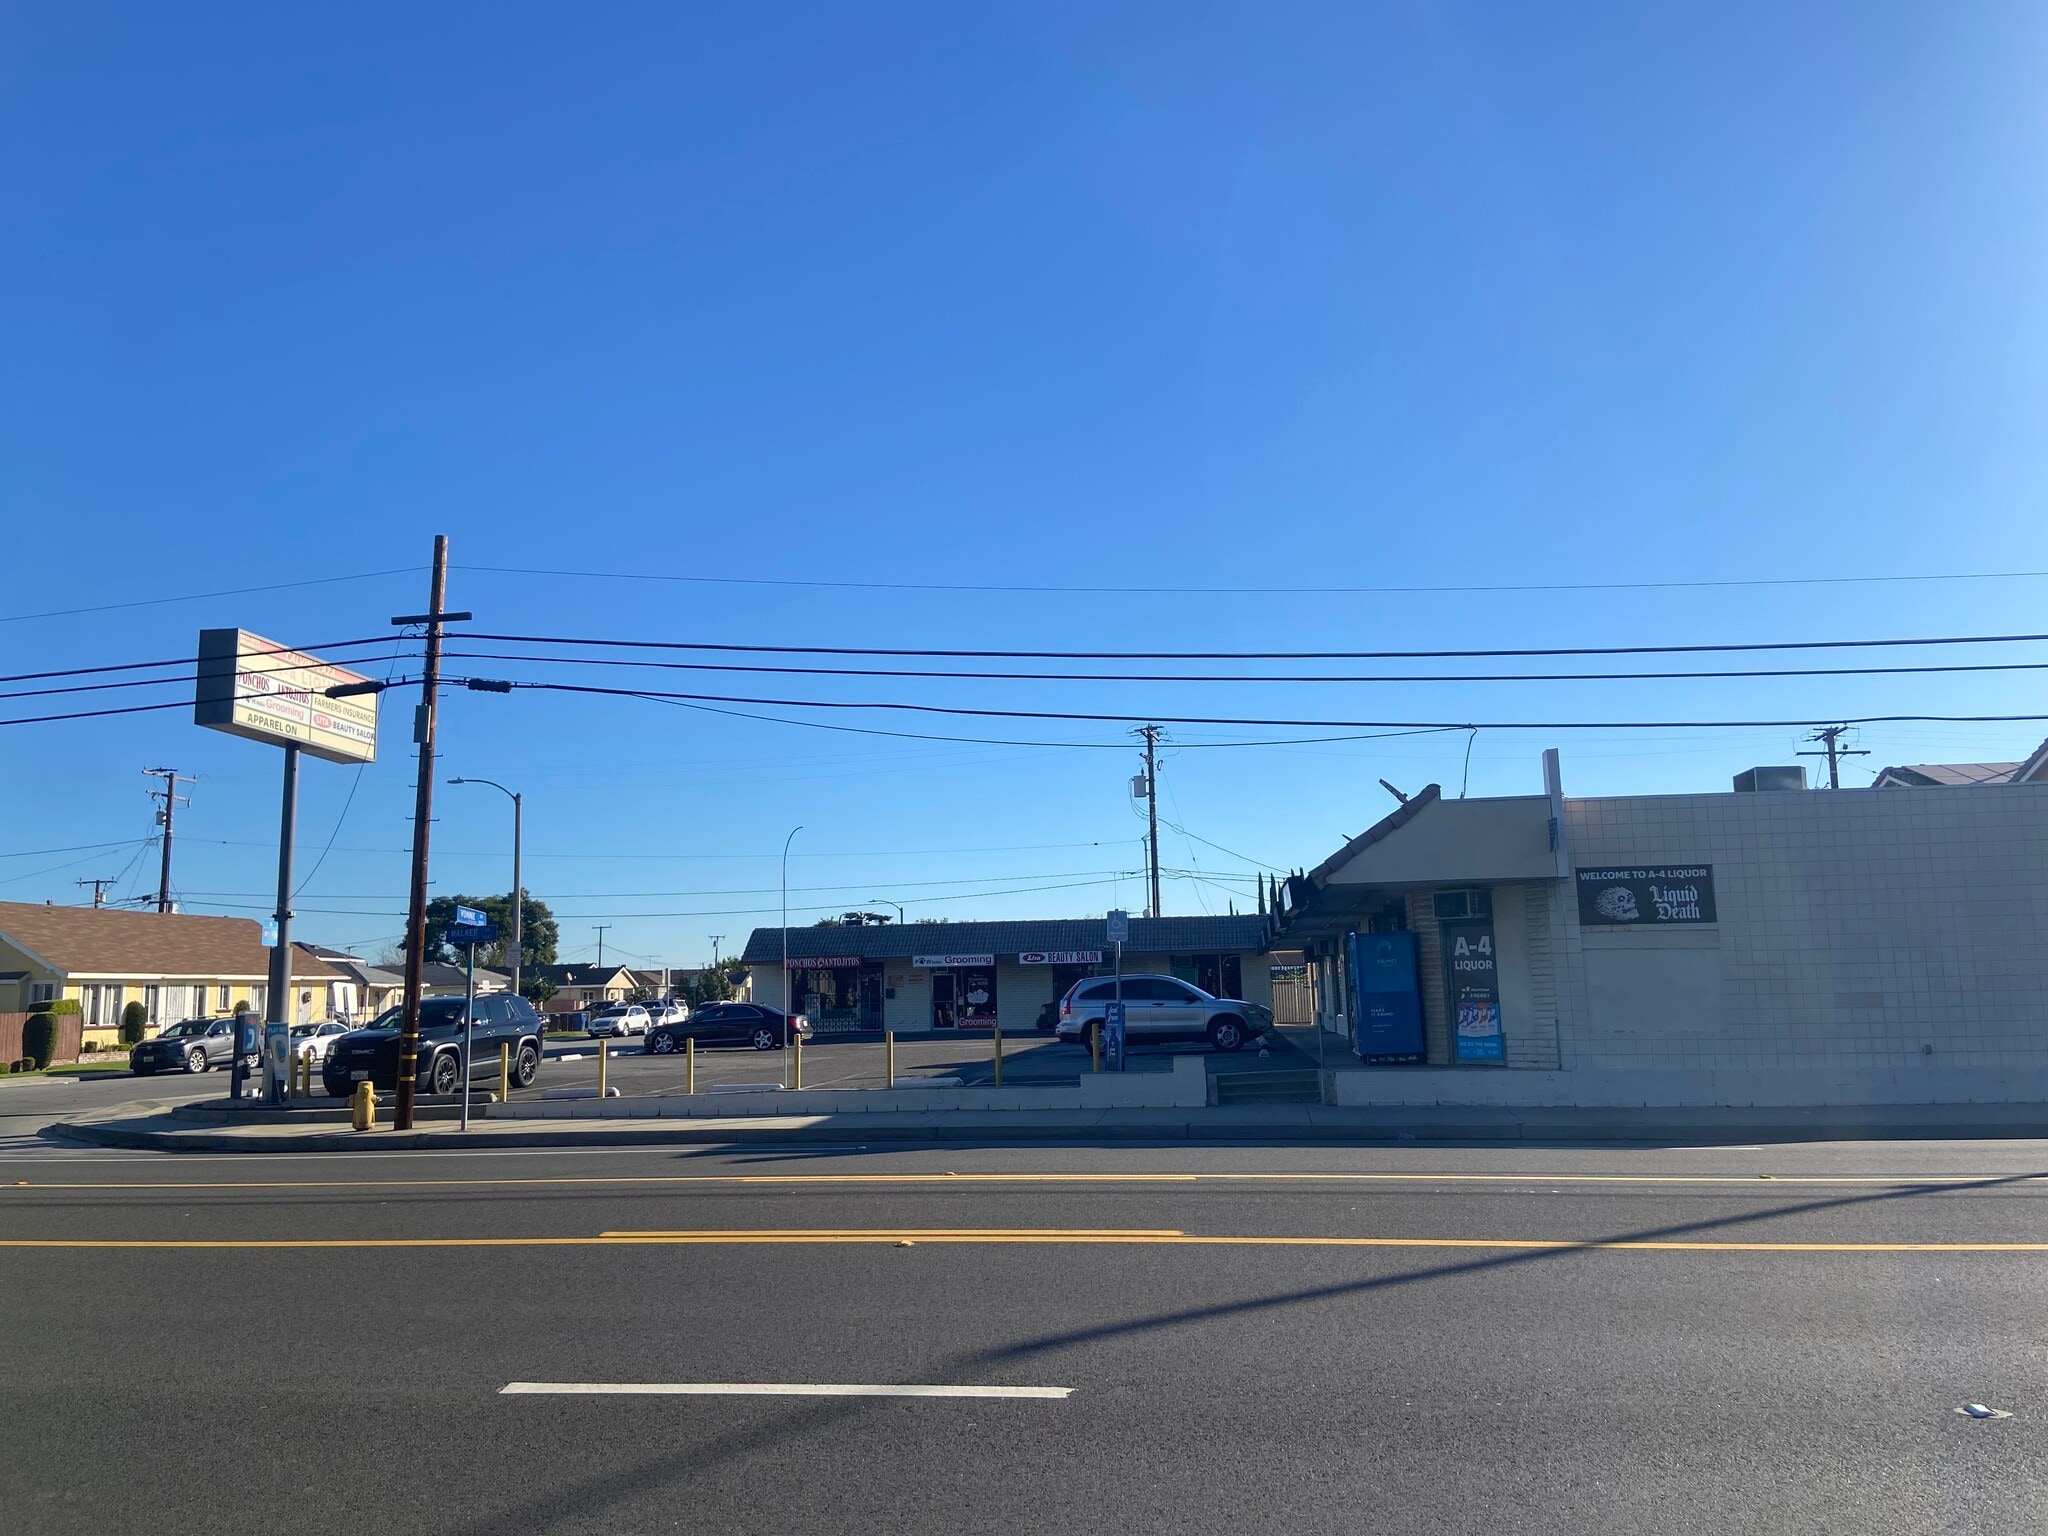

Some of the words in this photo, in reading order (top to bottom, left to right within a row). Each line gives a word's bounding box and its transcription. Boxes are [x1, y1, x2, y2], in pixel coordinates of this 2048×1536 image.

[238, 670, 270, 692] PONCHOS
[266, 698, 304, 721] Grooming
[314, 697, 342, 713] FARMERS
[343, 707, 375, 724] INSURANCE
[247, 713, 284, 732] APPAREL
[285, 723, 298, 736] ON
[333, 721, 355, 735] BEAUTY
[356, 728, 375, 741] SALON
[1580, 871, 1631, 880] WELCOME
[1632, 870, 1646, 879] TO
[1648, 870, 1666, 878] A-4
[1667, 868, 1707, 879] LIQUOR
[1649, 884, 1698, 906] Liquid
[1655, 900, 1701, 920] Death
[451, 928, 478, 937] WALKER
[1454, 935, 1492, 956] A-4
[786, 958, 816, 968] PONCHOS
[825, 957, 860, 967] ANTOJITOS
[944, 955, 992, 965] Grooming
[1048, 952, 1073, 962] BEAUTY
[1076, 951, 1098, 962] SALON
[1454, 960, 1493, 971] LIQUOR
[959, 1017, 997, 1027] Grooming
